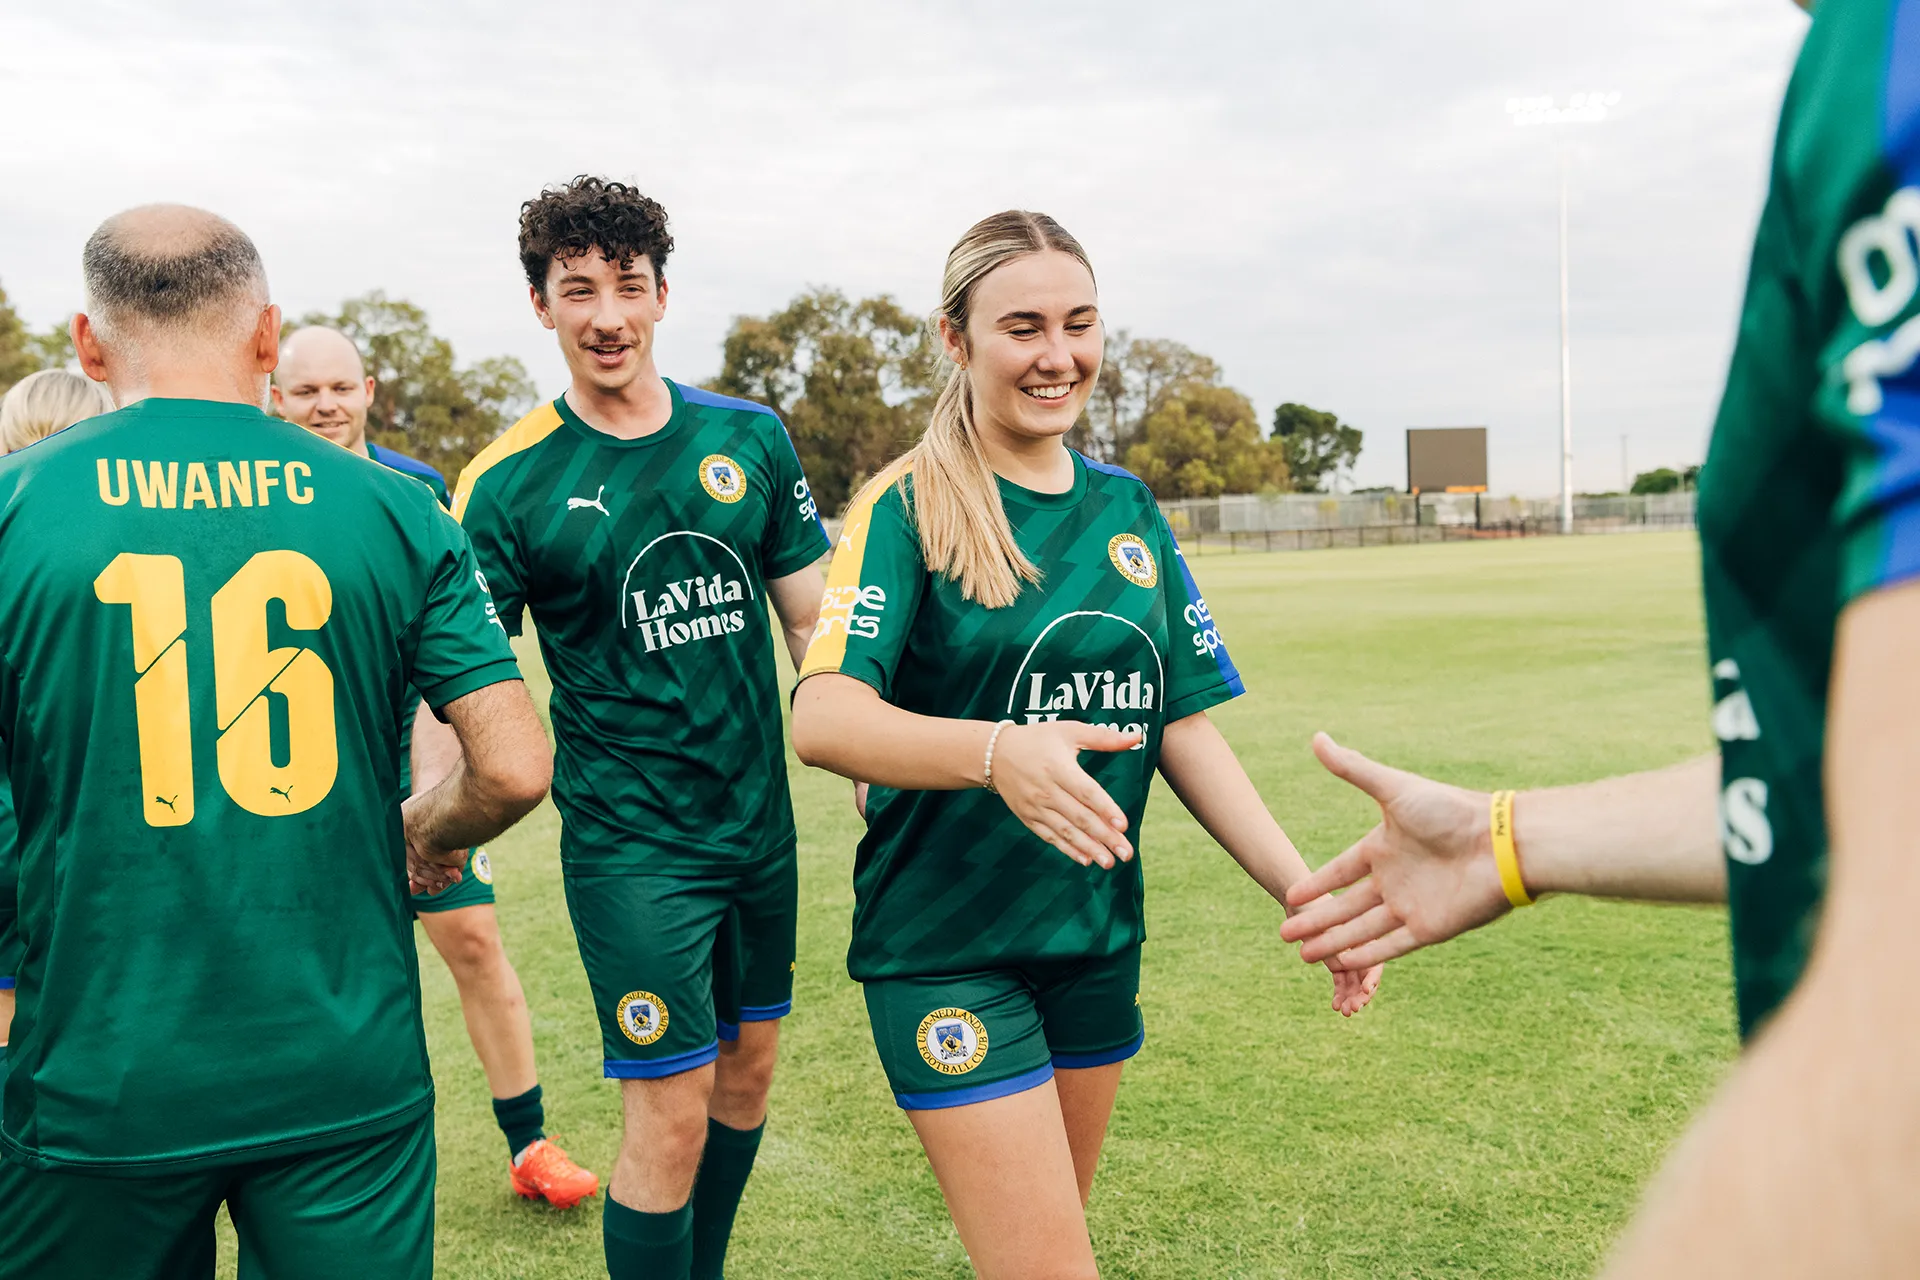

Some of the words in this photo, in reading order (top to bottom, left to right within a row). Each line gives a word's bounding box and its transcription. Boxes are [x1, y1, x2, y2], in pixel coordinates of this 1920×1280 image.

[96, 458, 315, 510] UWANFC
[630, 573, 744, 623] LaVida
[637, 610, 746, 653] Homes
[93, 549, 339, 828] 16
[1024, 670, 1155, 712] LaVida
[919, 1045, 974, 1074] FOOTBALL
[971, 1035, 988, 1064] CLUB
